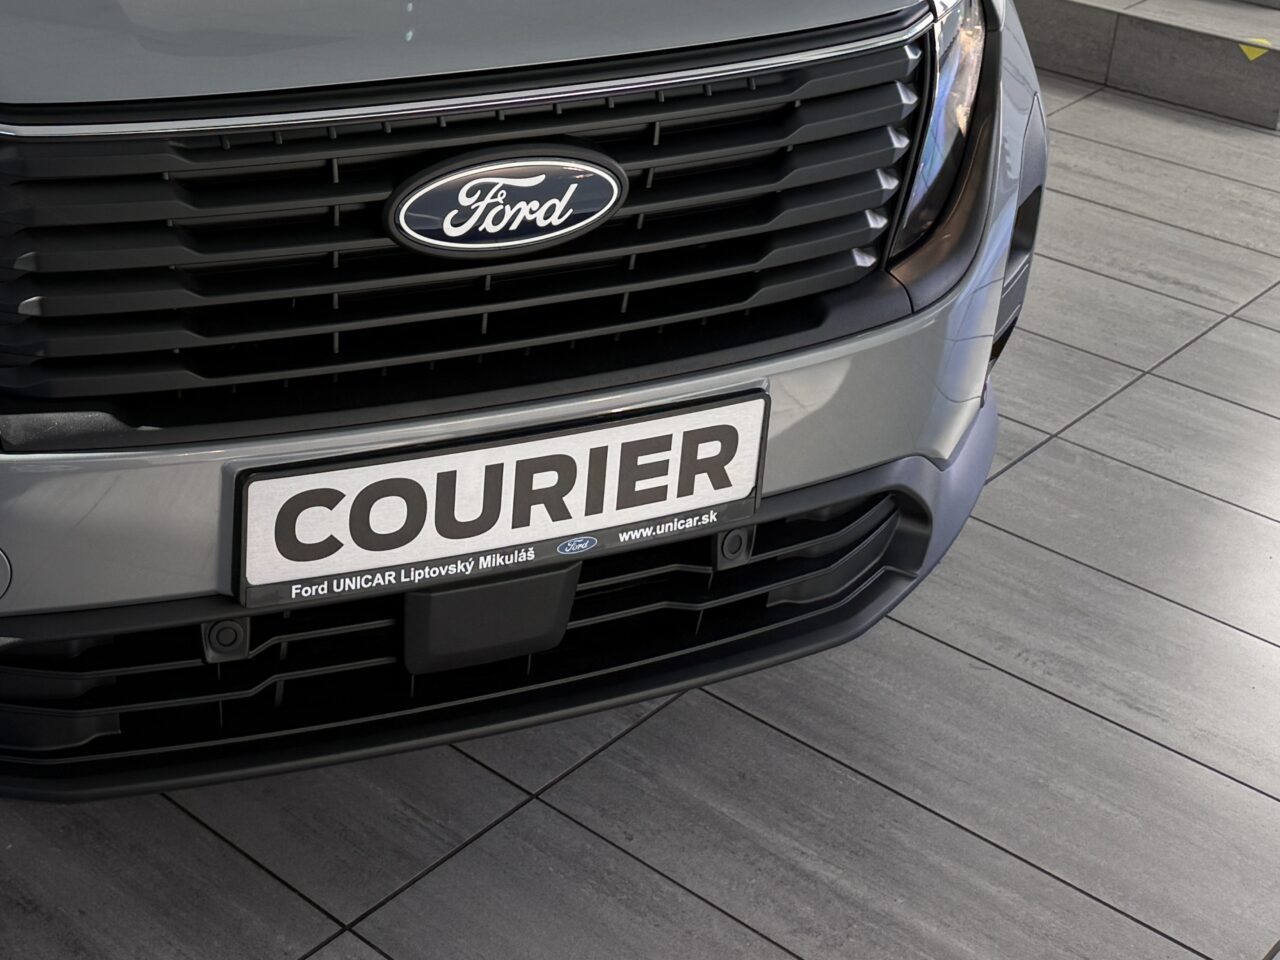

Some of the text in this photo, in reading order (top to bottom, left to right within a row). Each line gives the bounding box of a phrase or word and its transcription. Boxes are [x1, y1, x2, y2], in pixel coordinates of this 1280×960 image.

[442, 173, 579, 238] Ford
[273, 423, 740, 563] COURIER
[564, 538, 590, 554] Ford
[618, 509, 718, 543] www.unicar.sk
[290, 546, 536, 599] Ford UNICAR Liptovský Mikuláš
